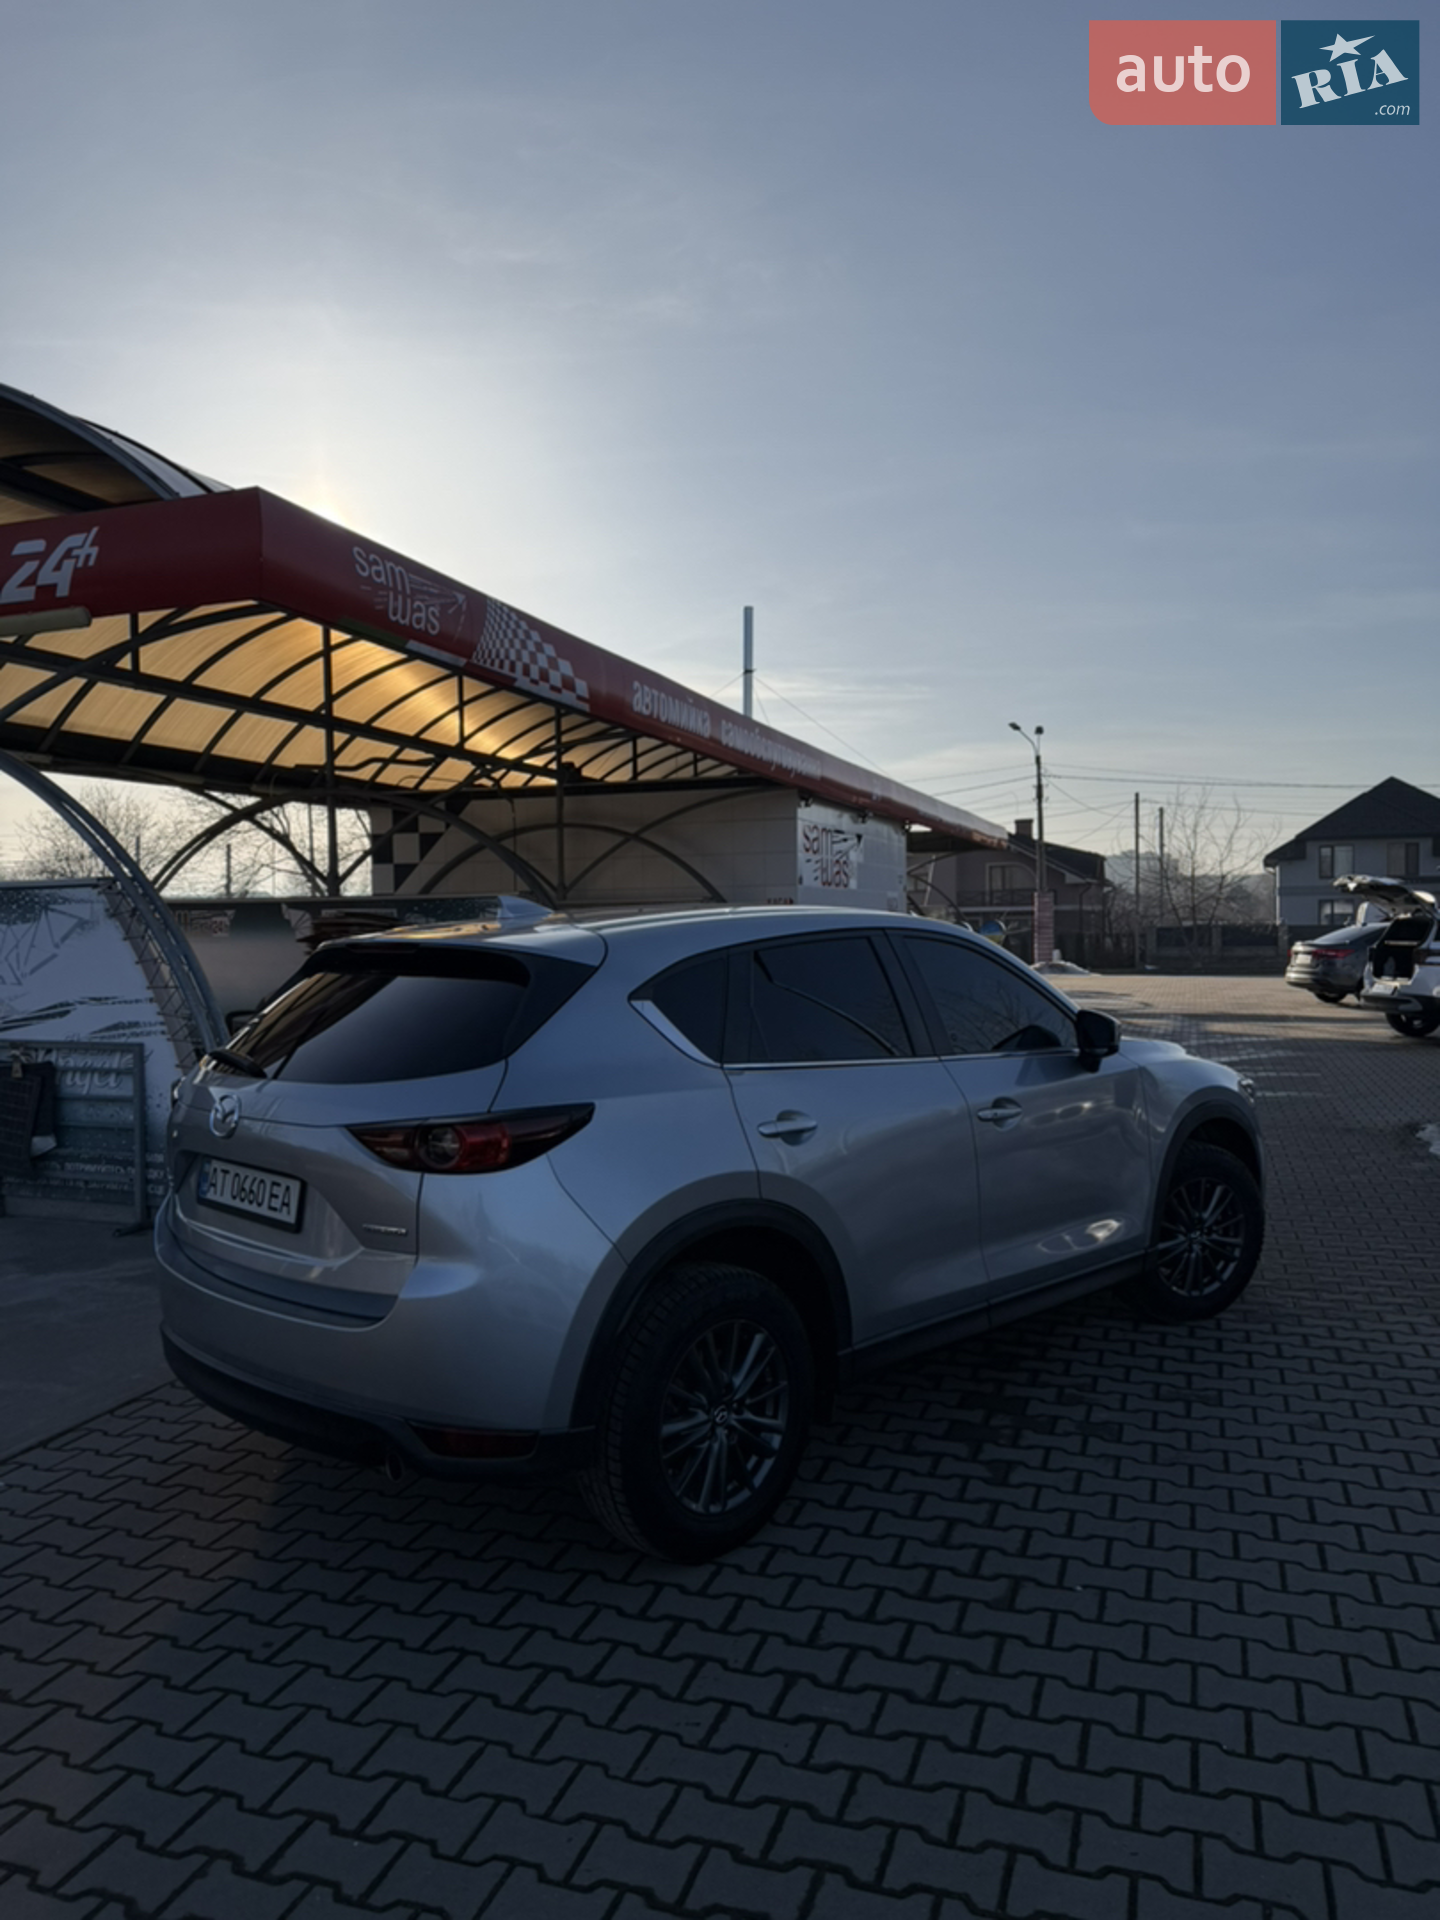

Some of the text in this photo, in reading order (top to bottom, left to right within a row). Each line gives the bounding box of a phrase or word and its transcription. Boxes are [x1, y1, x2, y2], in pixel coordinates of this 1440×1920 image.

[352, 546, 411, 595] sam
[632, 680, 711, 738] автомийка
[803, 824, 833, 857] sam
[207, 1167, 291, 1216] AT 0660 EA
